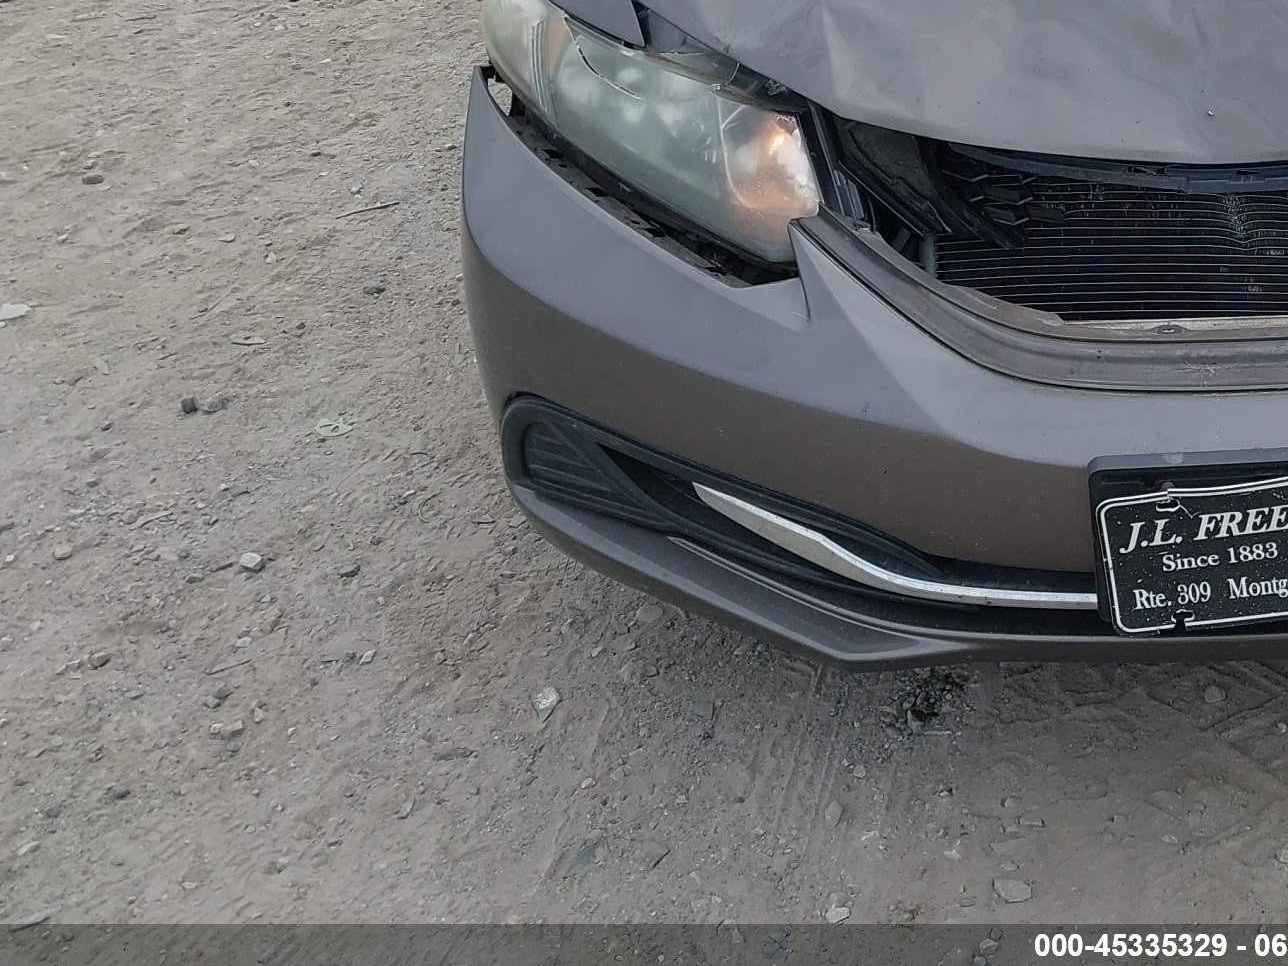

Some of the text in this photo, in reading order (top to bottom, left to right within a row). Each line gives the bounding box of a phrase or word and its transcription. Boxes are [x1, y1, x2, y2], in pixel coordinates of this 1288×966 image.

[1119, 518, 1183, 554] J.L.
[1162, 542, 1279, 573] Since 1883
[1132, 587, 1173, 611] Rte.
[1177, 581, 1212, 605] 309
